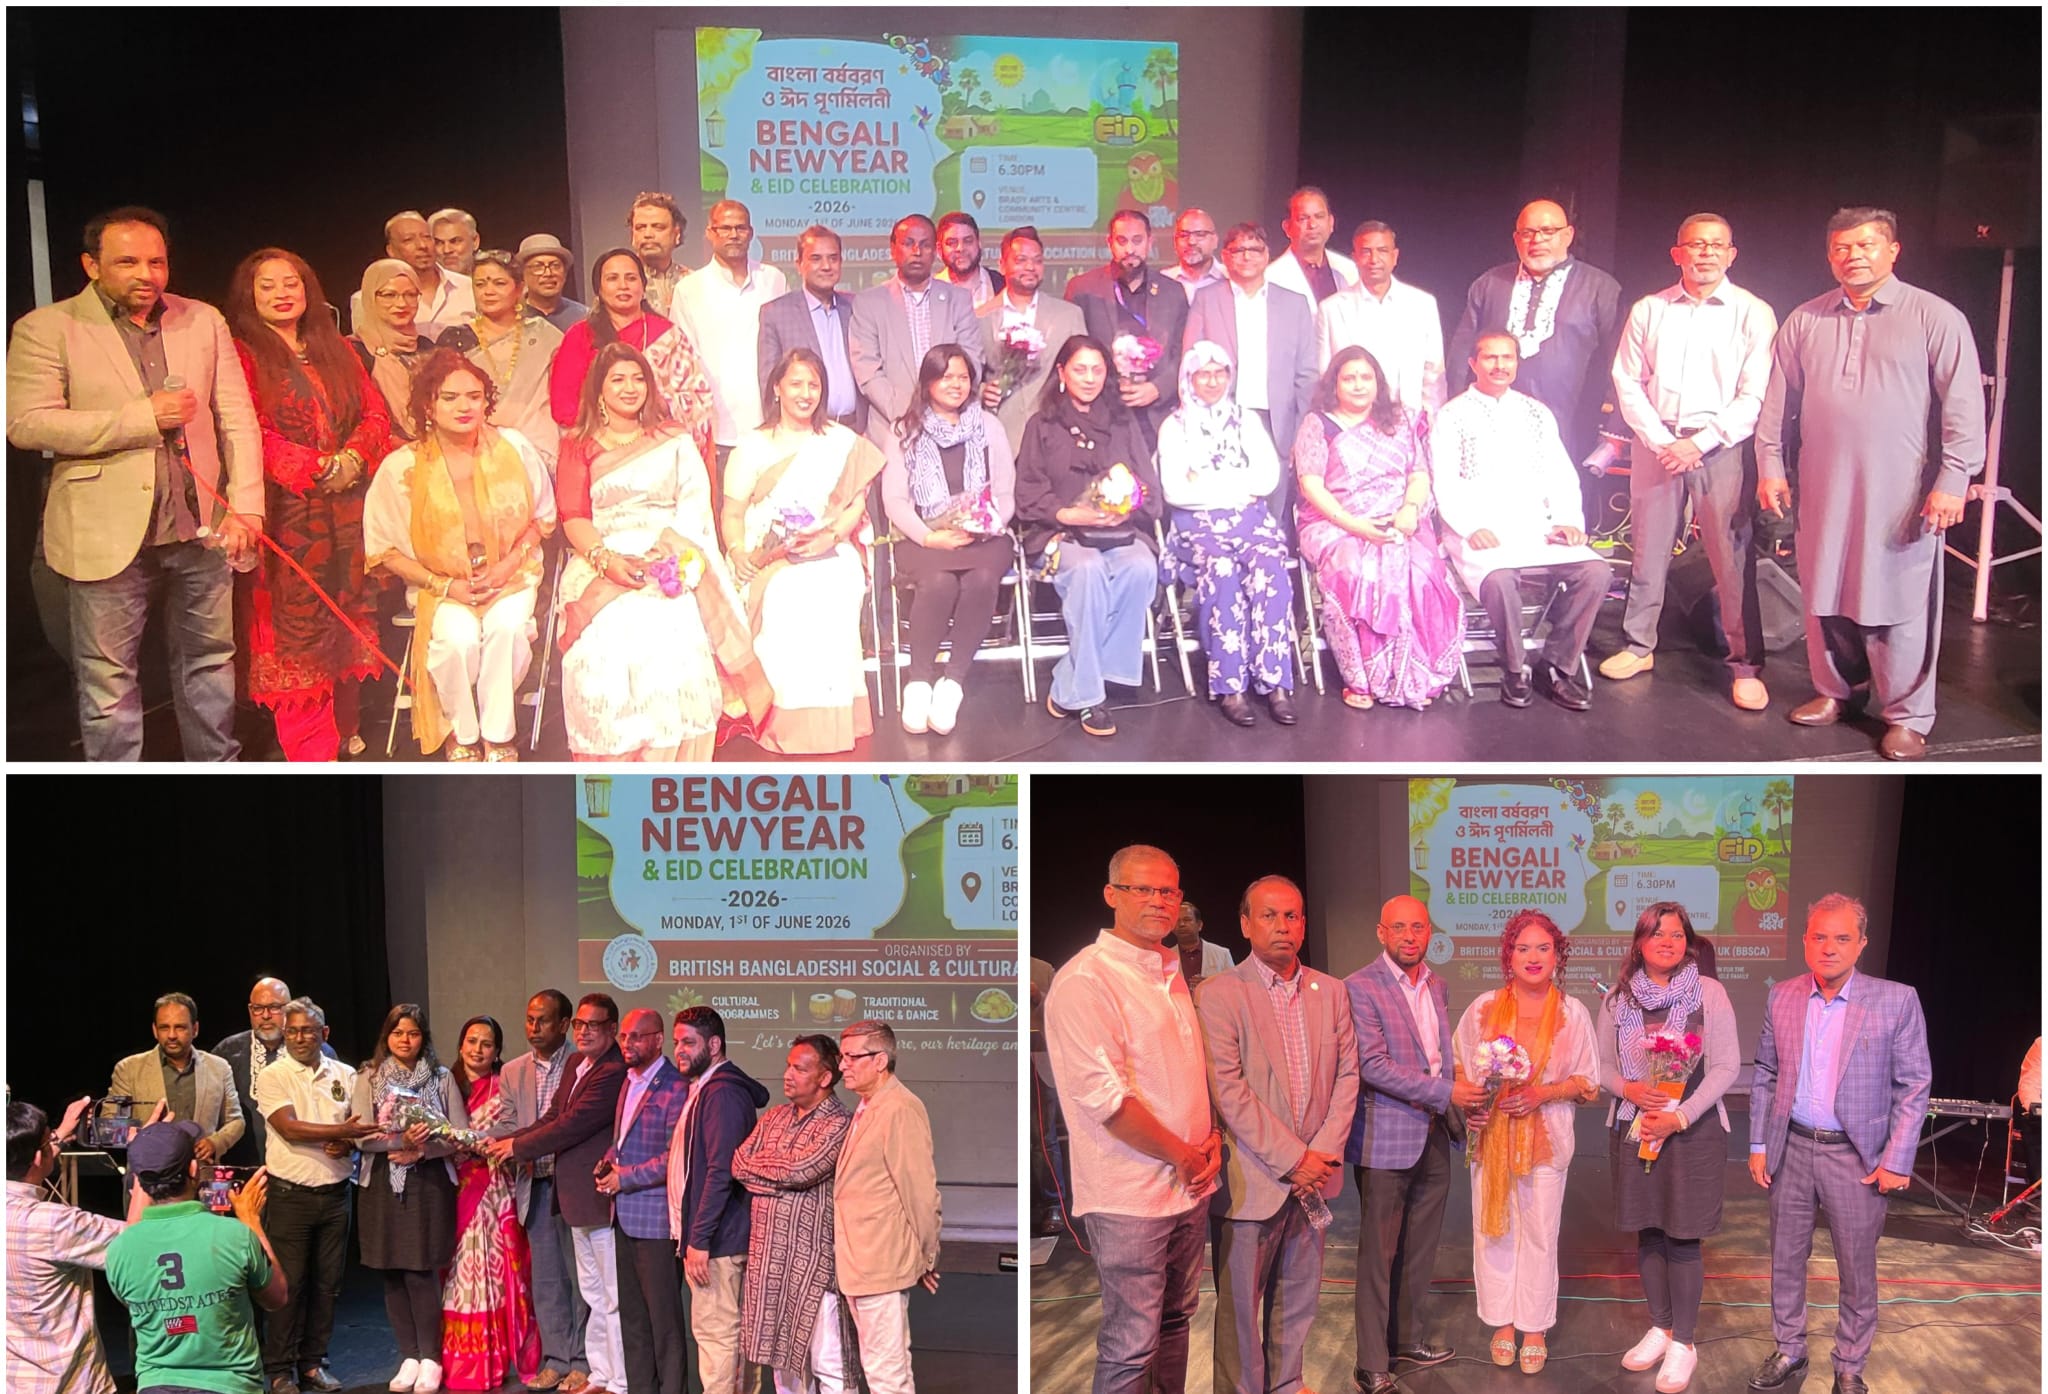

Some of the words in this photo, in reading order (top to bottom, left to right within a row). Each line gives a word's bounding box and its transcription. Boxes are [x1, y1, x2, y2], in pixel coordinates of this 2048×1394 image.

[766, 66, 818, 83] বাংলা
[822, 62, 884, 85] বর্ষবরণ
[762, 91, 775, 106] ও
[780, 87, 809, 108] ঈদ
[756, 120, 899, 146] BENGALI
[750, 149, 909, 173] NEWYEAR
[998, 164, 1045, 176] 6.30PM
[751, 178, 763, 194] &
[768, 178, 795, 194] EID
[800, 178, 911, 194] CELEBRATION
[765, 218, 809, 229] MONDAY
[831, 219, 845, 228] OF
[847, 218, 873, 228] JUNE
[651, 775, 852, 813] BENGALI
[1458, 806, 1498, 819] বাংলা
[1501, 802, 1549, 819] বর্ষবরণ
[642, 815, 865, 852] NEWYEAR
[1456, 826, 1466, 838] ও
[1469, 822, 1491, 838] ঈদ
[1451, 847, 1559, 868] BENGALI
[642, 859, 660, 881] &
[666, 859, 703, 880] EID
[709, 858, 868, 880] CELEBRATION
[1445, 869, 1567, 889] NEWYEAR
[1636, 880, 1676, 889] 6.30PM
[1446, 892, 1455, 904] &
[1458, 892, 1479, 904] EID
[1482, 892, 1567, 904] CELEBRATION
[661, 915, 725, 931] MONDAY,
[752, 915, 771, 929] OF
[774, 915, 812, 929] JUNE
[816, 915, 851, 929] 2026
[1456, 923, 1491, 932] MONDAY,
[885, 945, 952, 957] ORGANISED
[955, 945, 971, 957] BY
[1460, 946, 1496, 956] BRITISH
[1567, 946, 1594, 956] OCIAL
[1597, 946, 1604, 956] &
[1606, 946, 1628, 956] CULT
[1717, 946, 1730, 956] UK
[1732, 945, 1770, 957] (BBSCA)
[669, 959, 734, 977] BRITISH
[739, 959, 857, 977] BANGLADESHI
[862, 959, 924, 977] SOCIAL
[929, 960, 940, 977] &
[945, 959, 1018, 977] CULTUR
[711, 996, 760, 1006] CULTURAL
[863, 996, 927, 1007] TRADITIONAL
[718, 1009, 780, 1020] ROGRAMMES
[863, 1010, 895, 1021] MUSIC
[897, 1010, 904, 1021] &
[907, 1010, 939, 1021] DANCE
[921, 1041, 944, 1050] our
[947, 1036, 999, 1056] heritage
[1002, 1041, 1018, 1050] an
[157, 1252, 186, 1291] 3
